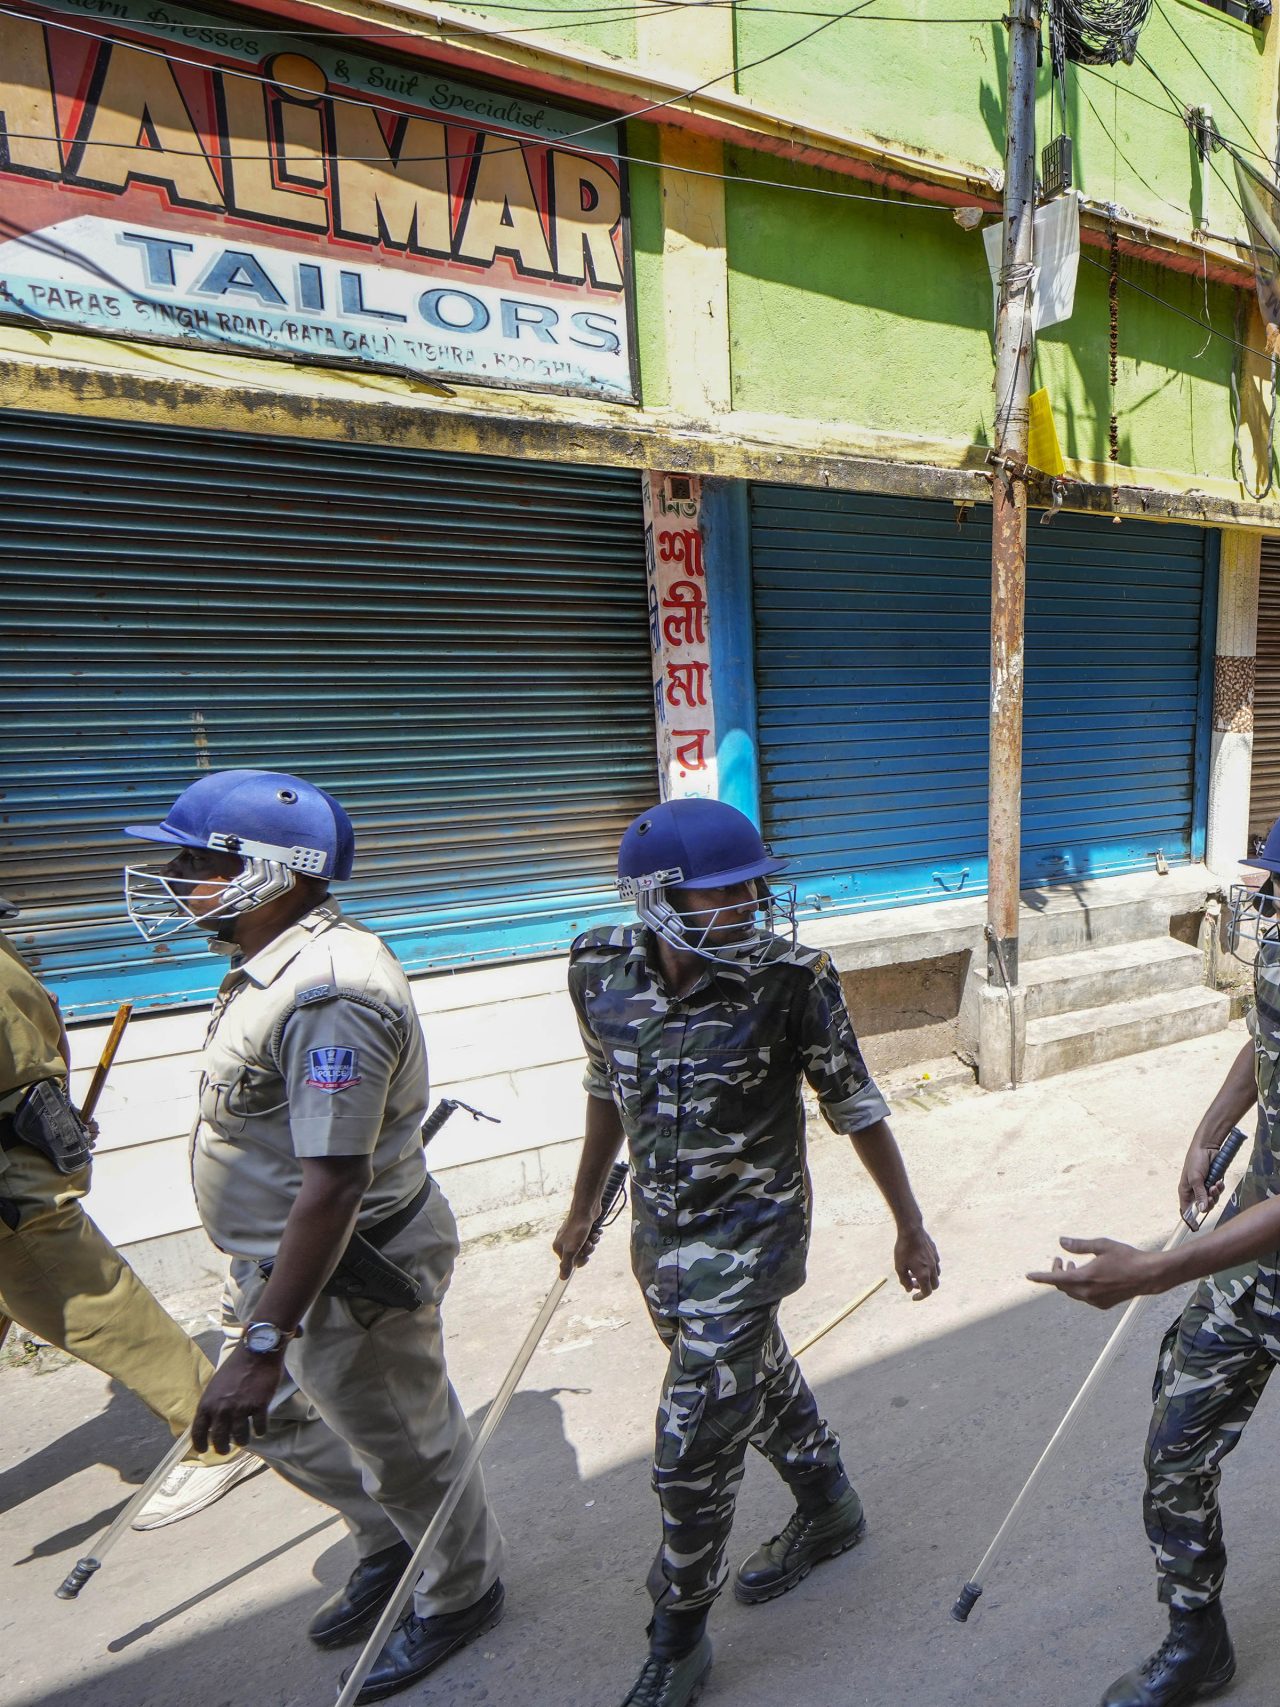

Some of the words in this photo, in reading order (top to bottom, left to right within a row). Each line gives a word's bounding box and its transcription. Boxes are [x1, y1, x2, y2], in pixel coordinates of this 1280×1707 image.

[147, 8, 259, 56] Dresses
[333, 59, 351, 83] &
[367, 66, 418, 97] Suit
[27, 284, 121, 317] PARAS
[119, 231, 621, 353] TAILORS
